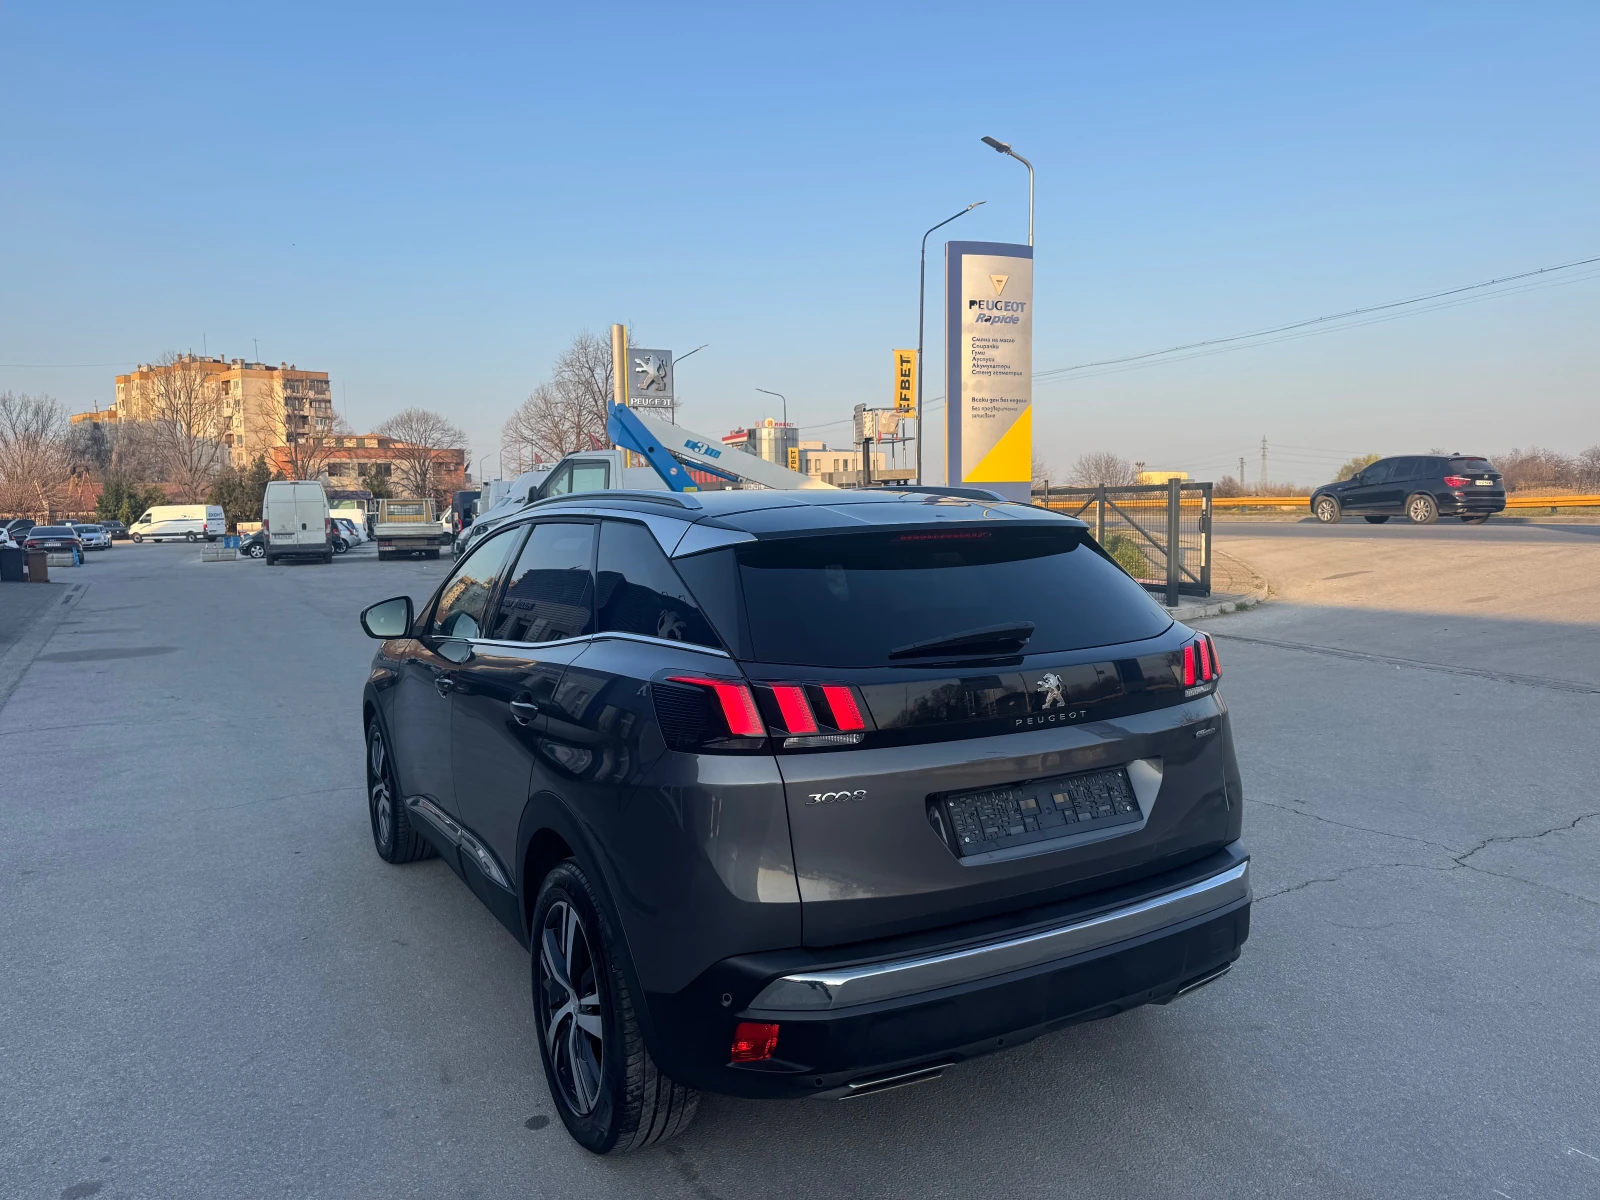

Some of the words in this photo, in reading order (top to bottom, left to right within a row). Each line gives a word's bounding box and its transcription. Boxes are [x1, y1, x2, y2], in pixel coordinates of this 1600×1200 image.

[969, 299, 1027, 312] PEUGEOT
[975, 312, 1020, 326] Rapide
[971, 369, 992, 377] Стенд
[630, 397, 672, 406] PEUGEOT
[1015, 710, 1087, 727] PEUGEOT
[805, 789, 868, 806] 3008
